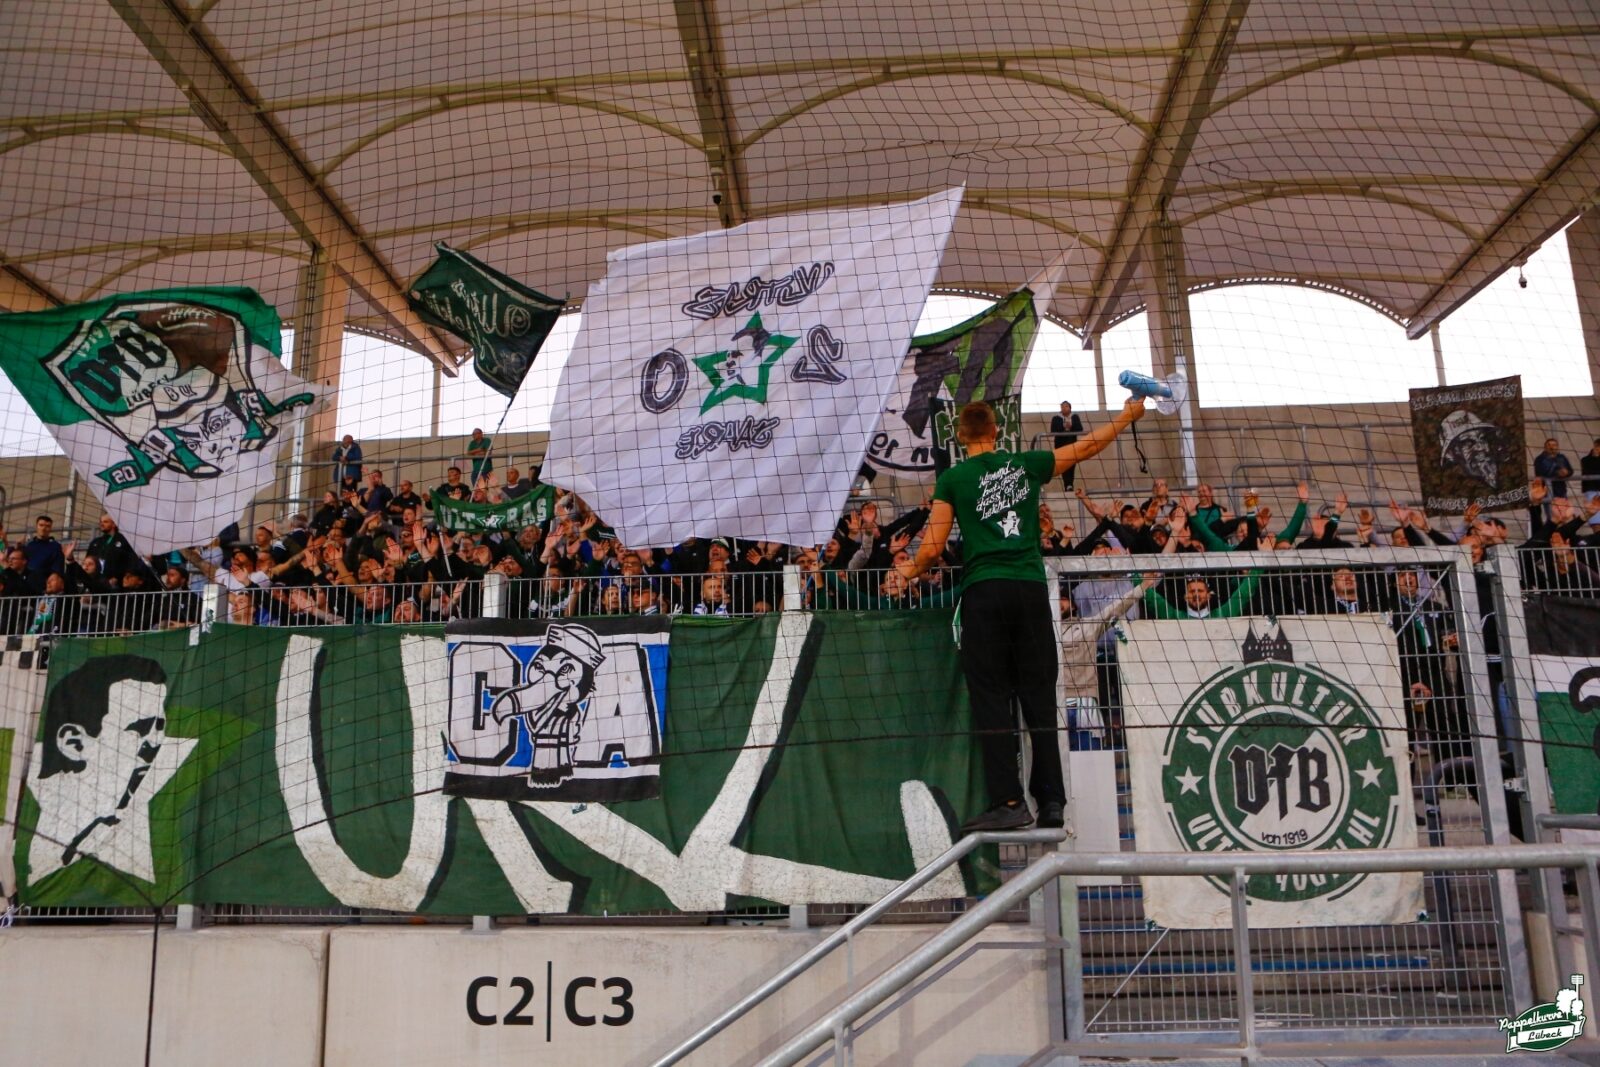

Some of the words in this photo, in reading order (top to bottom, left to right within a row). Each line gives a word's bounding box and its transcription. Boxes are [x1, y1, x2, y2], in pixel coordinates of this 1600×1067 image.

[111, 465, 137, 484] 20
[1186, 670, 1368, 752] SUBKULTUR
[1283, 829, 1309, 845] 1919
[466, 976, 535, 1026] C2
[564, 976, 635, 1027] C3
